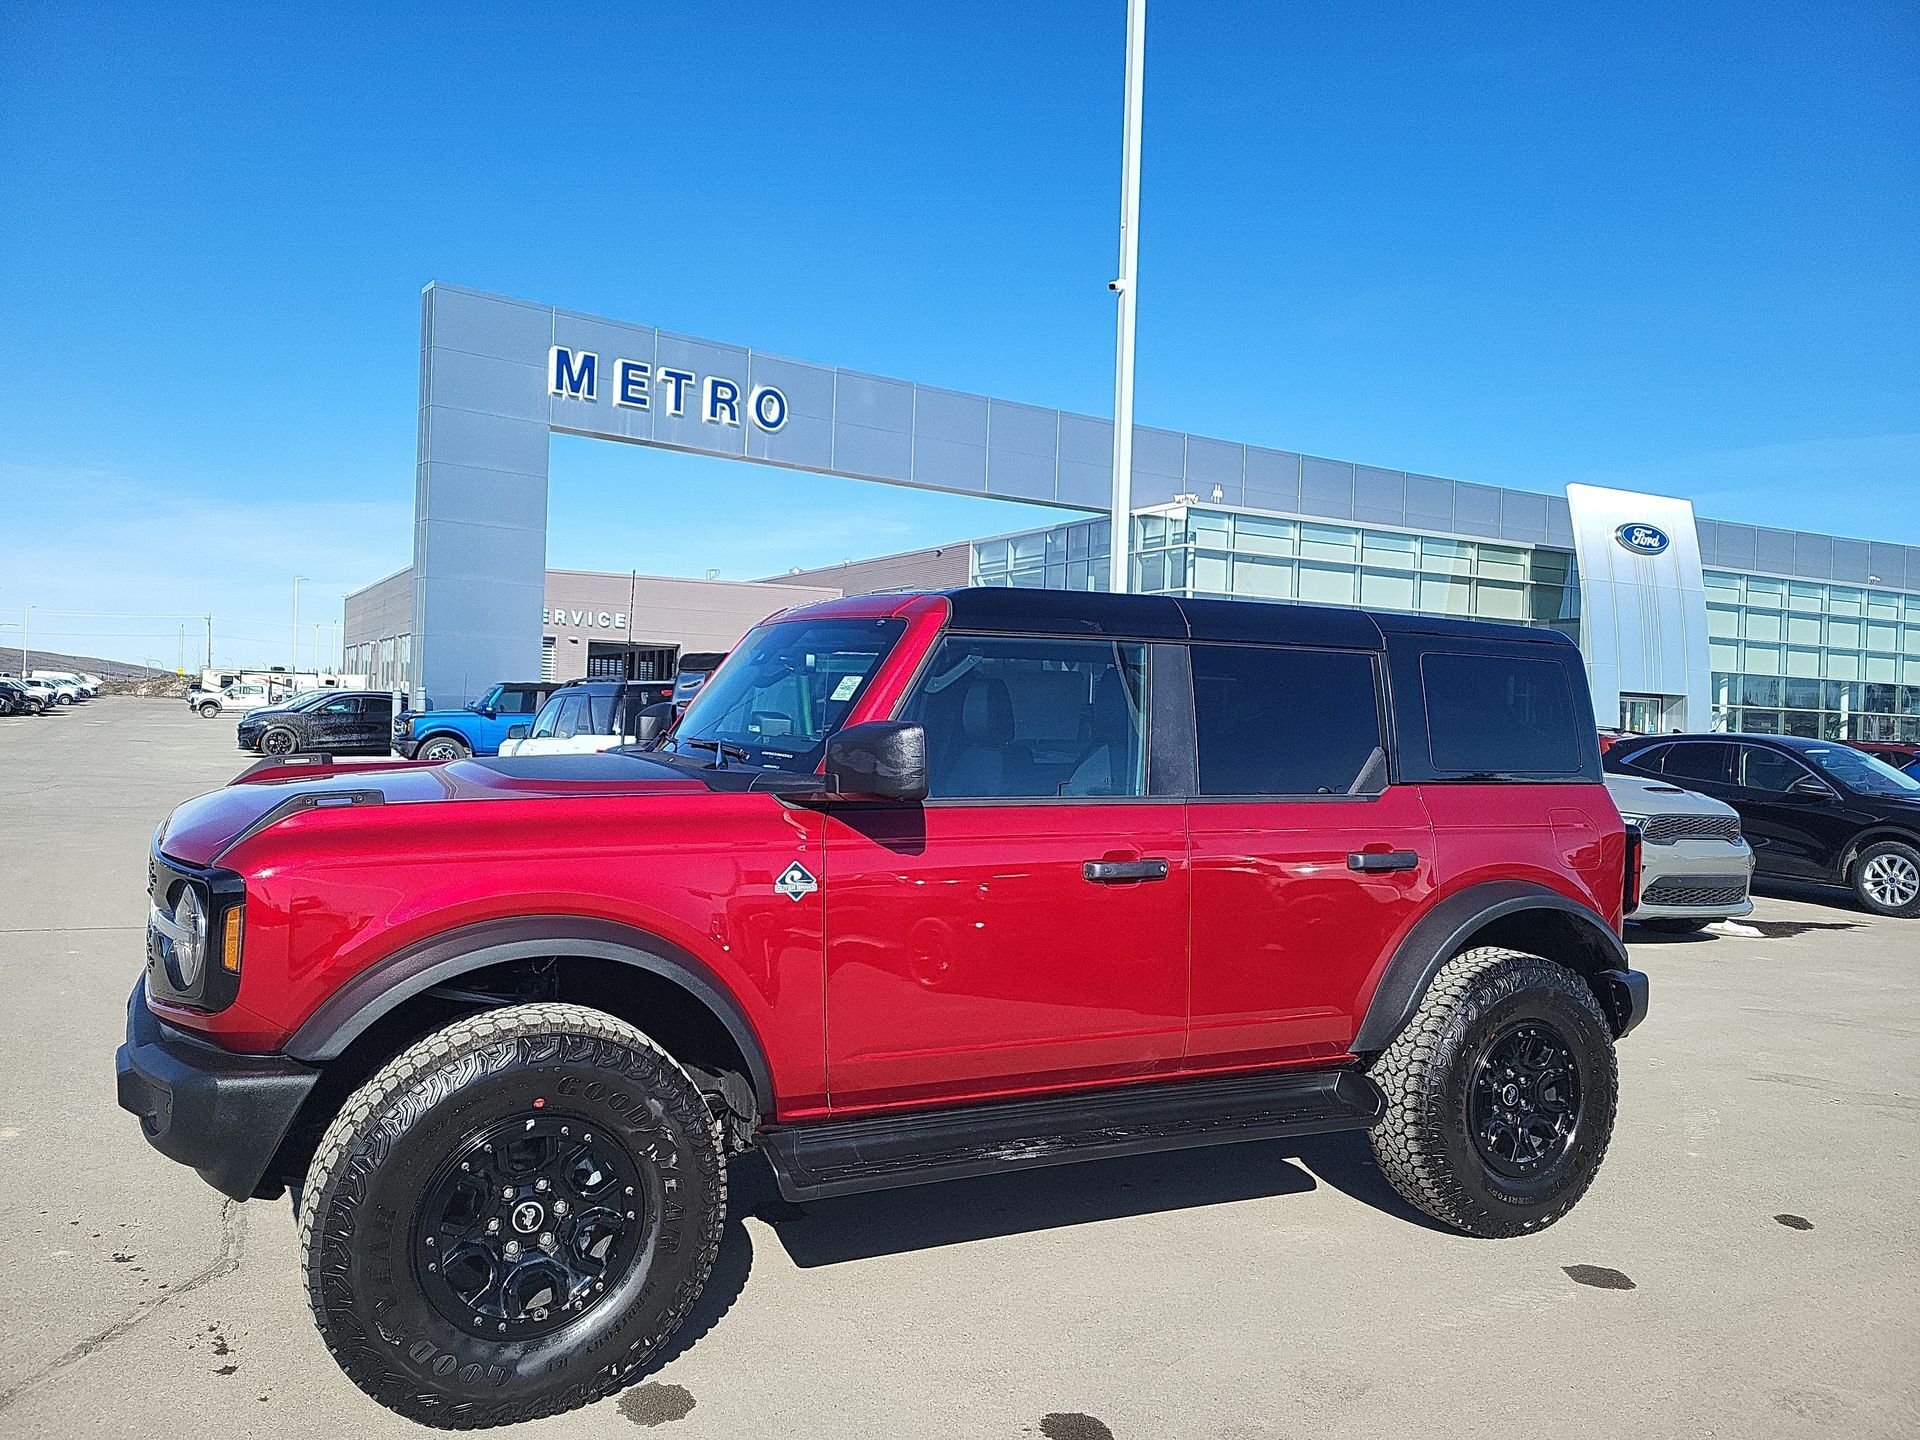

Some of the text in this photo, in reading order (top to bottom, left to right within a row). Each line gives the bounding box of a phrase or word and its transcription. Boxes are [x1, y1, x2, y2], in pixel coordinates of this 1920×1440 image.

[549, 345, 789, 433] METRO
[1632, 528, 1660, 547] Ford
[543, 608, 626, 628] ERVICE
